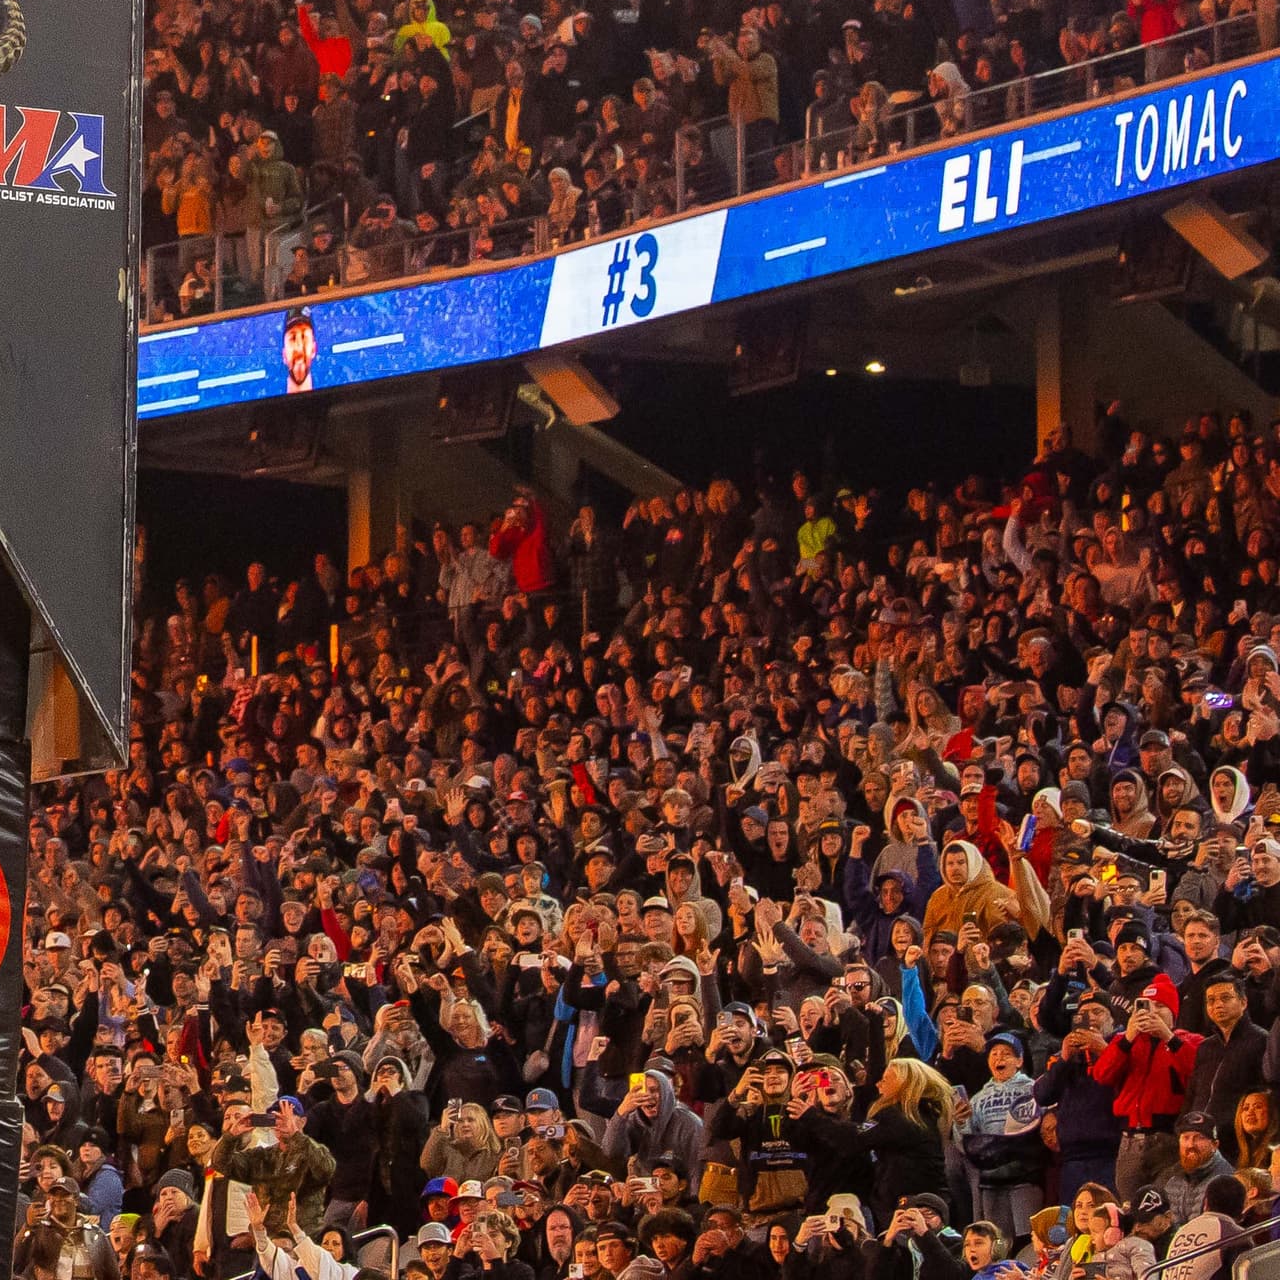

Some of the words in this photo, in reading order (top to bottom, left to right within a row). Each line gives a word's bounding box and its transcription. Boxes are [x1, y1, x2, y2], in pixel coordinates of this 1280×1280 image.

[938, 139, 1025, 233] ELI
[1113, 79, 1248, 187] TOMAC
[36, 193, 116, 211] ASSOCIATION
[602, 233, 659, 327] #3
[1174, 1233, 1208, 1248] CSC
